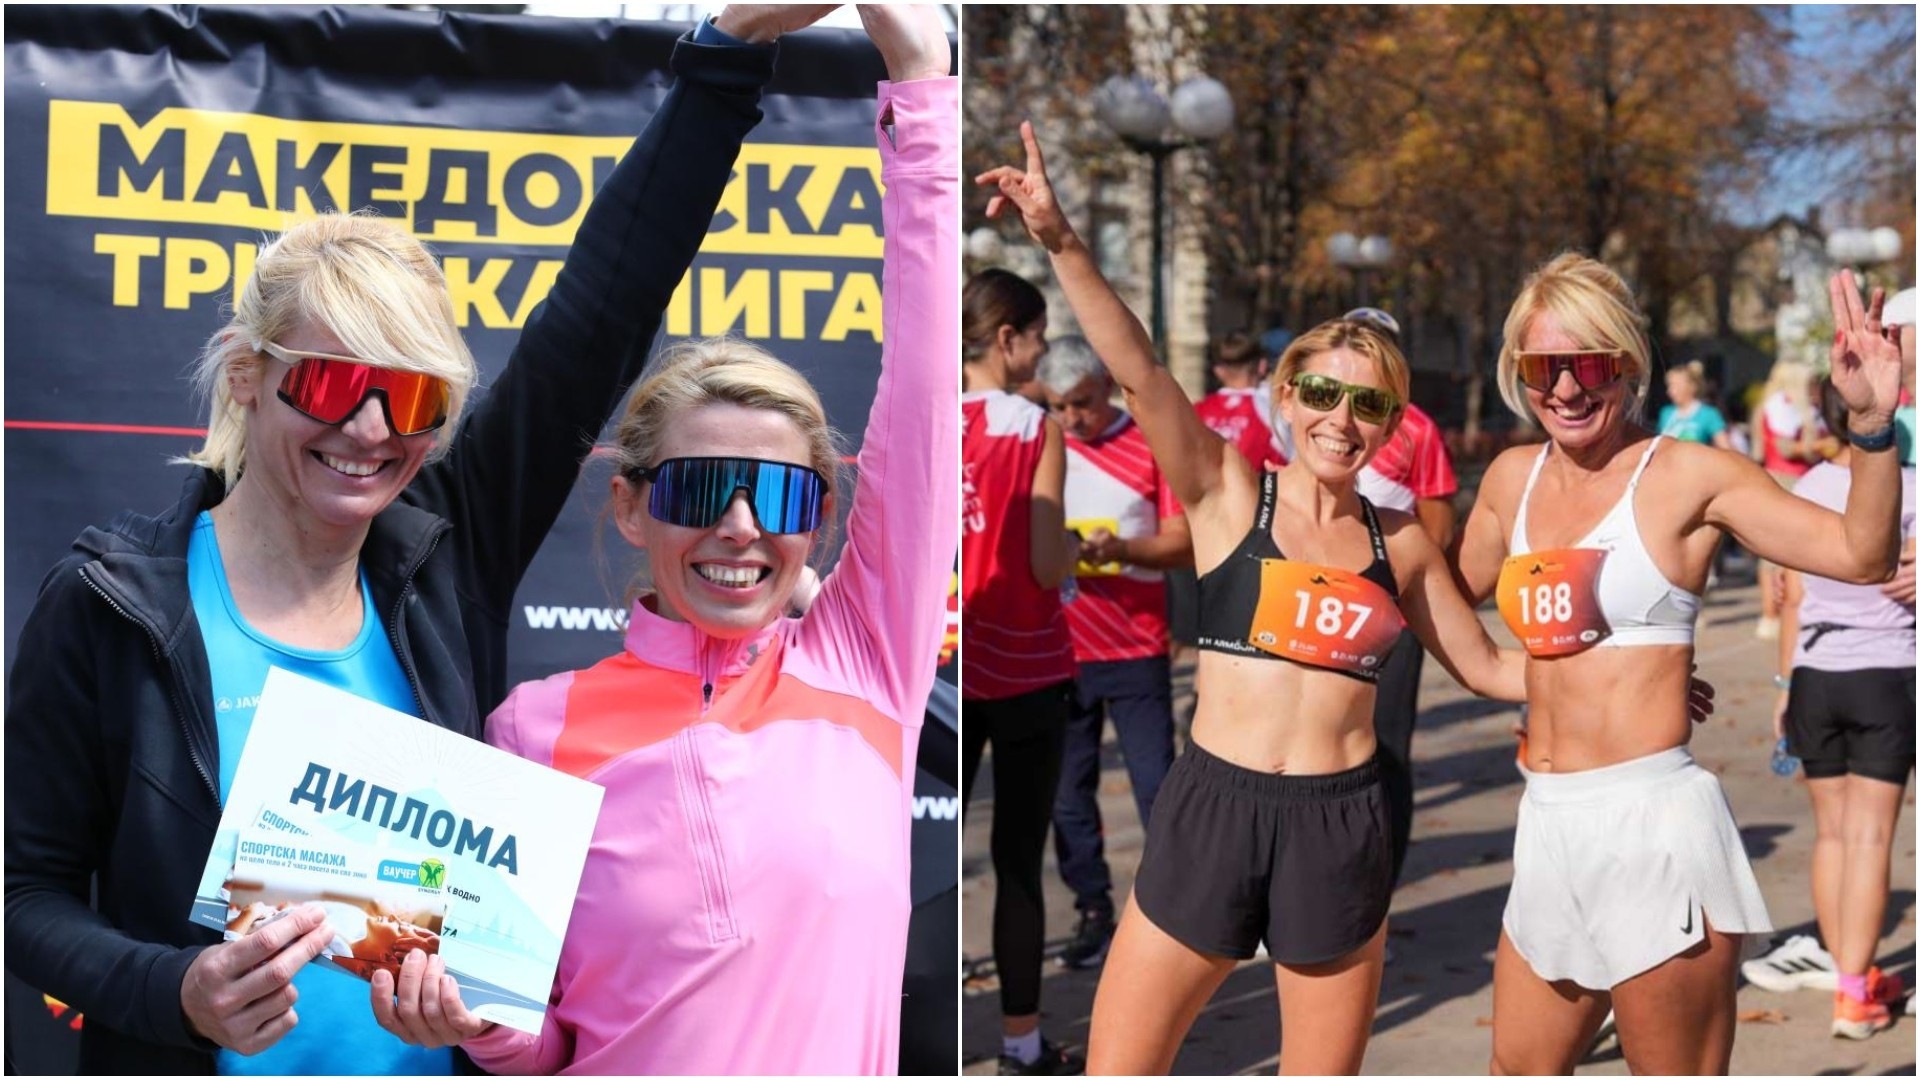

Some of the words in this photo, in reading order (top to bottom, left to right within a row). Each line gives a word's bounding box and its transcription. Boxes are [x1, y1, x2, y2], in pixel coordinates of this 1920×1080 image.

[97, 122, 884, 238] МАКЕДОКА
[1295, 589, 1373, 641] 187
[1517, 582, 1573, 626] 188
[289, 762, 519, 876] ДИПЛОМА
[241, 841, 296, 860] СПОРТСКА
[300, 849, 346, 867] МАСАЖА
[383, 865, 417, 880] ВАУЧЕР
[452, 887, 481, 903] ВОДНО
